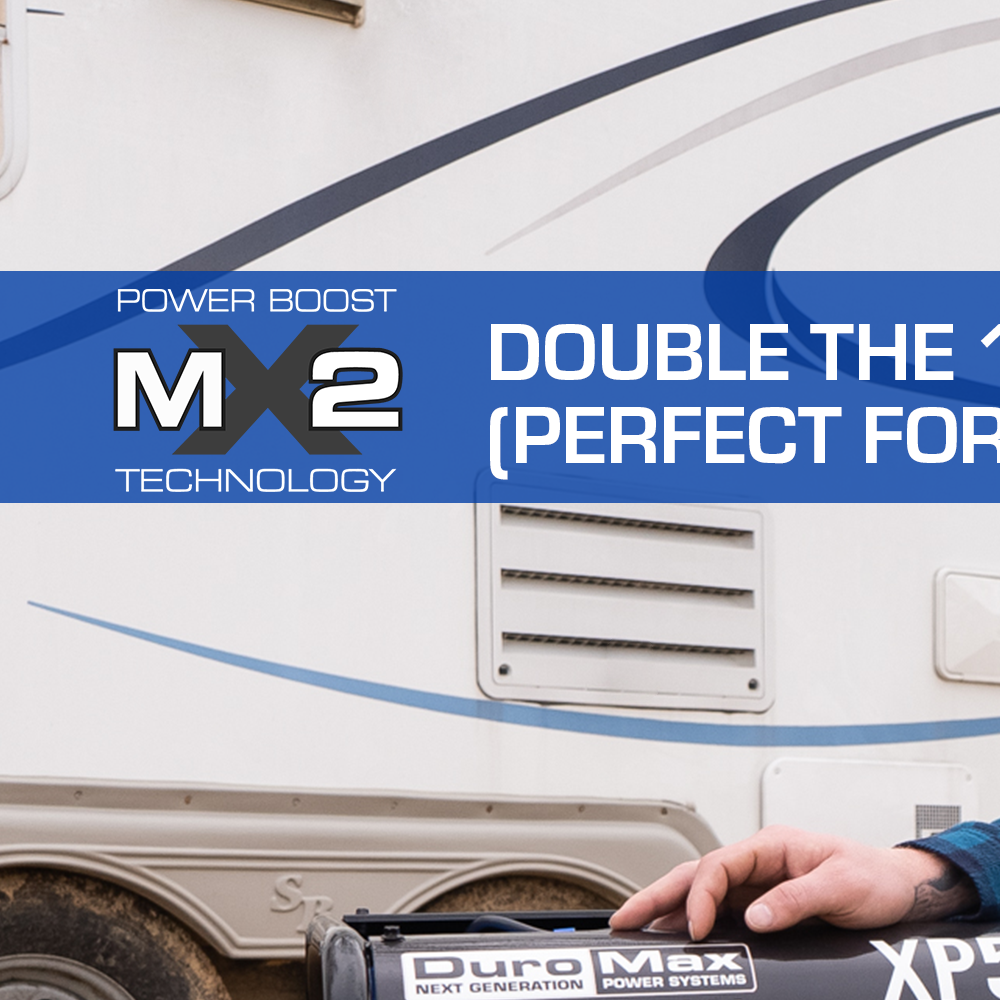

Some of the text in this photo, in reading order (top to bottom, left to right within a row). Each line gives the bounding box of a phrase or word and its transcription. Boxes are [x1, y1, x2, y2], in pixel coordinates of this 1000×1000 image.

[416, 979, 583, 995] NEXT GENERATION
[602, 974, 747, 989] POWER SYSTEMS
